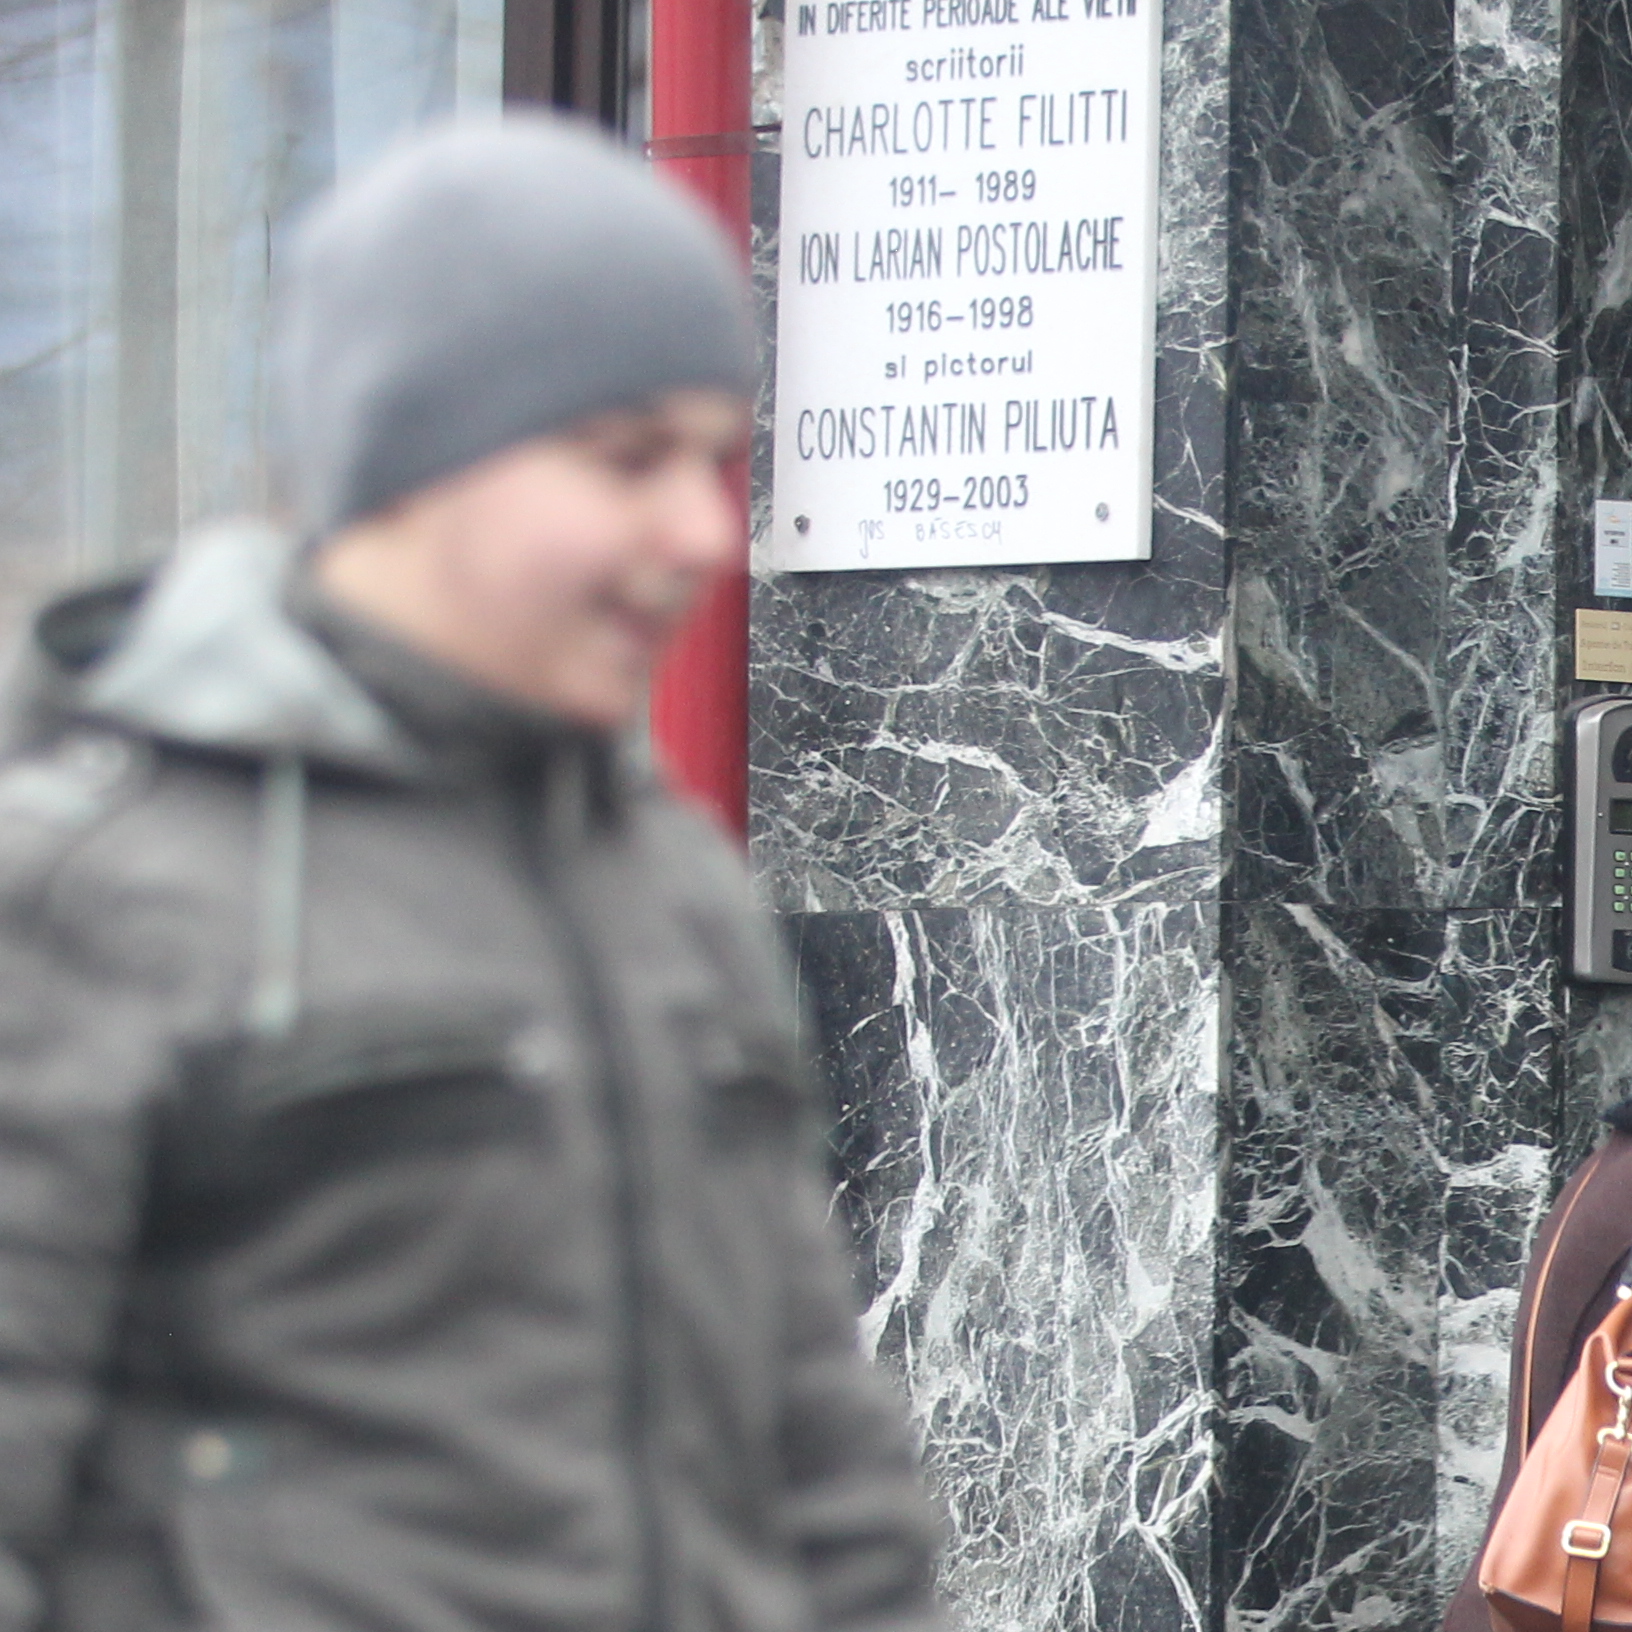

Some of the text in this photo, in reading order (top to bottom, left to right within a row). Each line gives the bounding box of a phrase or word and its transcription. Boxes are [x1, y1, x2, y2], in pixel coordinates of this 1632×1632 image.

[798, 4, 816, 36] IN
[827, 1, 911, 35] DIFERITE
[923, 0, 1019, 28] PERIOADE
[1031, 0, 1069, 22] ALE
[905, 44, 1024, 82] scriitorii
[803, 89, 1127, 159] CHARLOTTE FILITTI
[975, 168, 1037, 204] 1989
[800, 216, 1124, 285] ION LARIAN POSTOLACHE
[884, 349, 1033, 385] si pictorul
[797, 395, 1119, 461] CONSTANTIN PILIUTA
